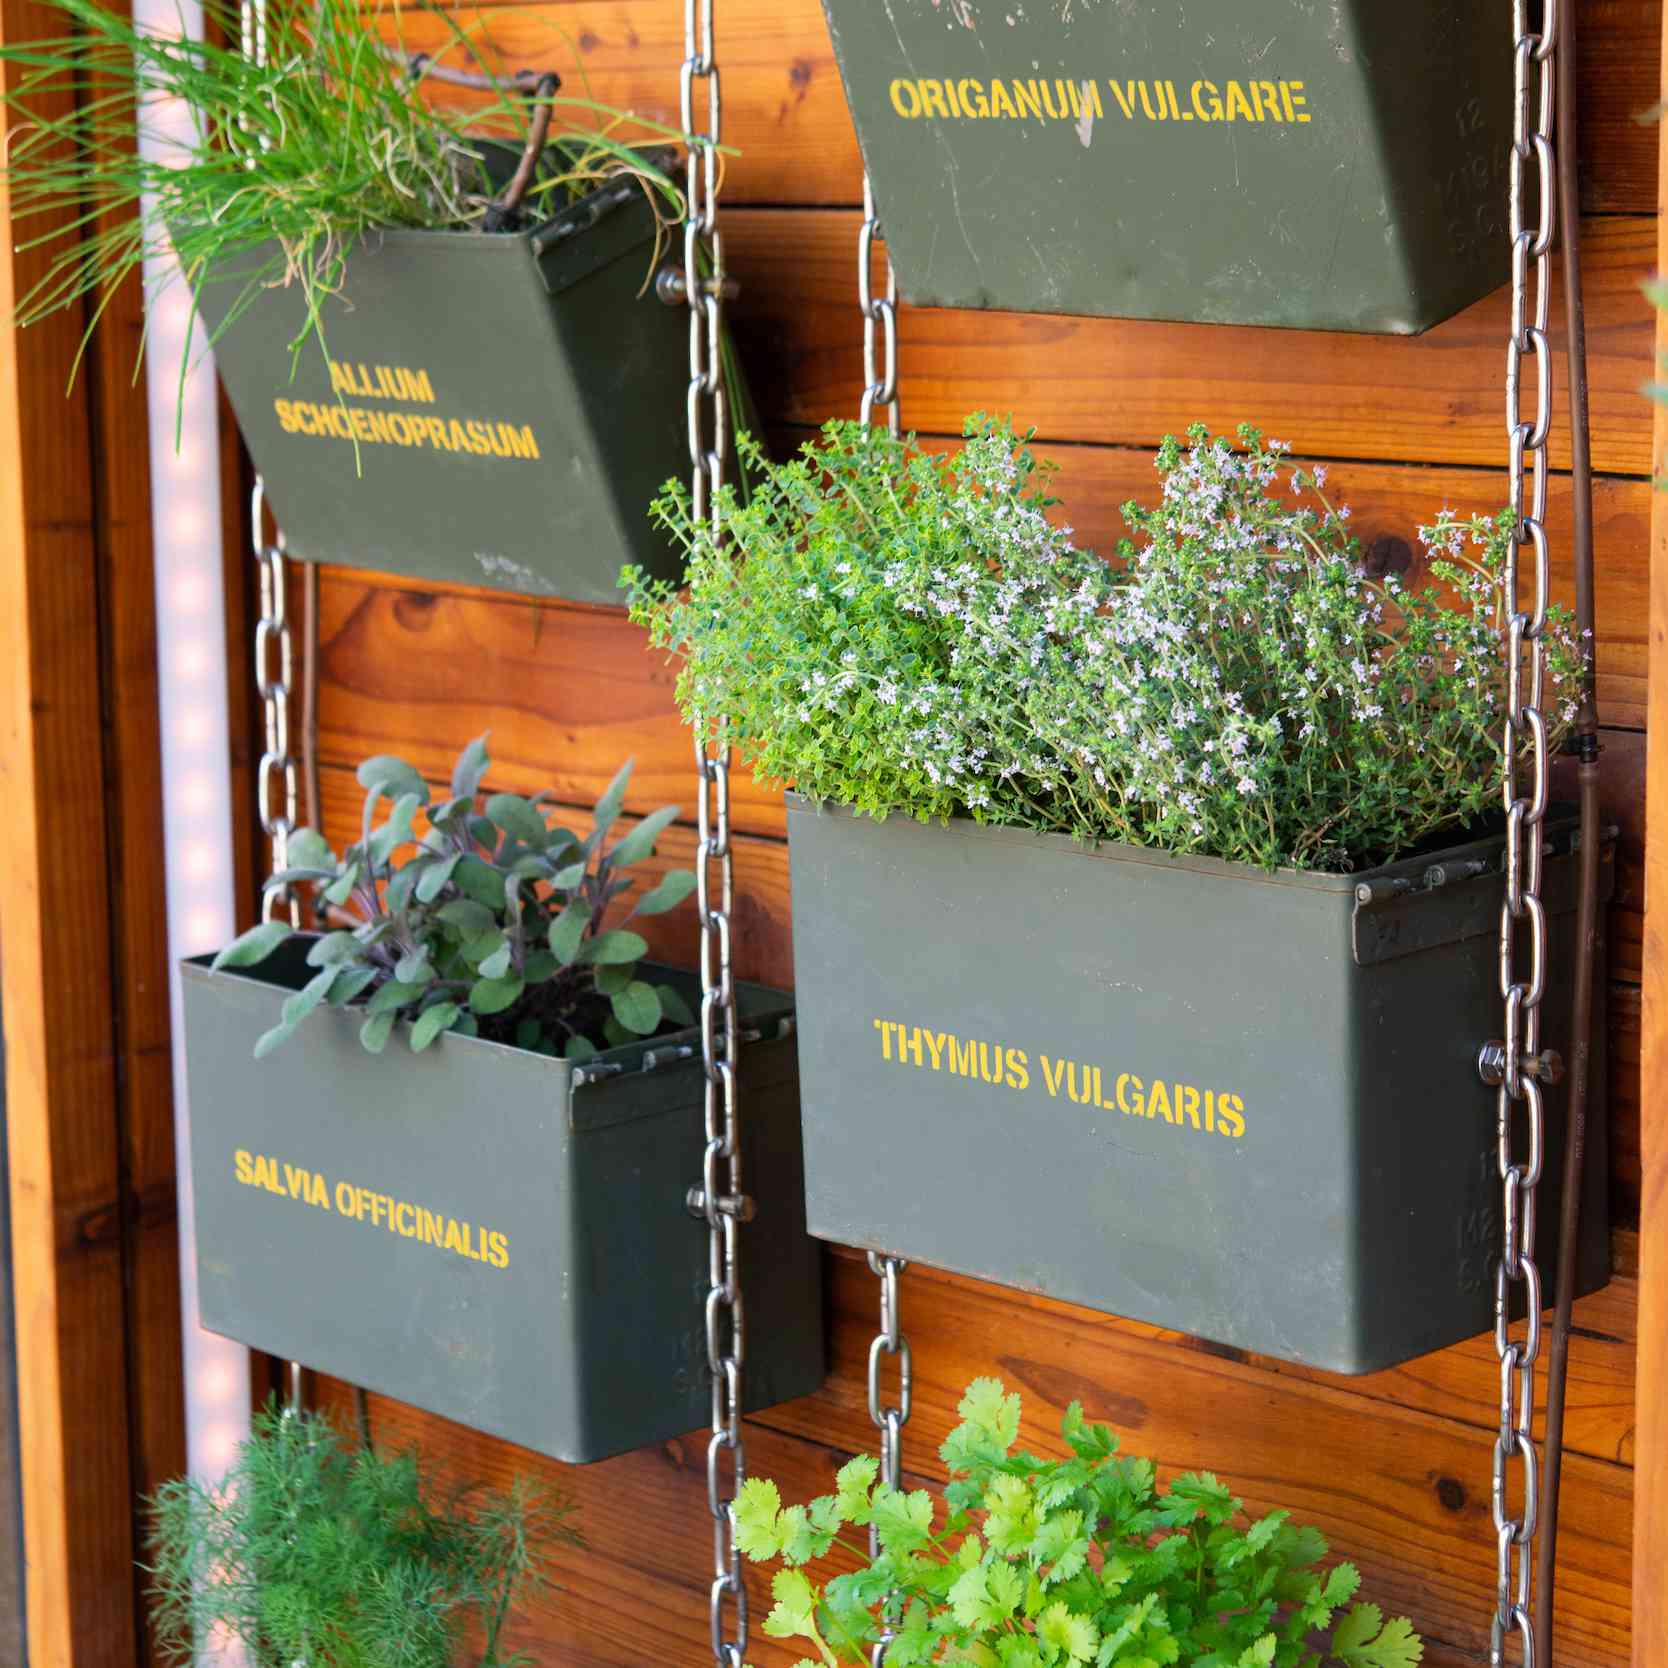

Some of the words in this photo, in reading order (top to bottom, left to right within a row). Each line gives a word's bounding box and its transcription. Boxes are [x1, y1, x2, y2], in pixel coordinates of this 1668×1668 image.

[889, 79, 1104, 120] ORIGANUM
[1108, 80, 1312, 122] VULGARE
[329, 360, 436, 403] ALLIUM
[274, 397, 541, 459] SCHOENOPRASUM
[873, 1018, 1030, 1090] THYMUS
[1039, 1055, 1246, 1138] VULGARIS
[234, 1149, 331, 1210] SALVIA
[335, 1182, 511, 1269] OFFICINALIS
